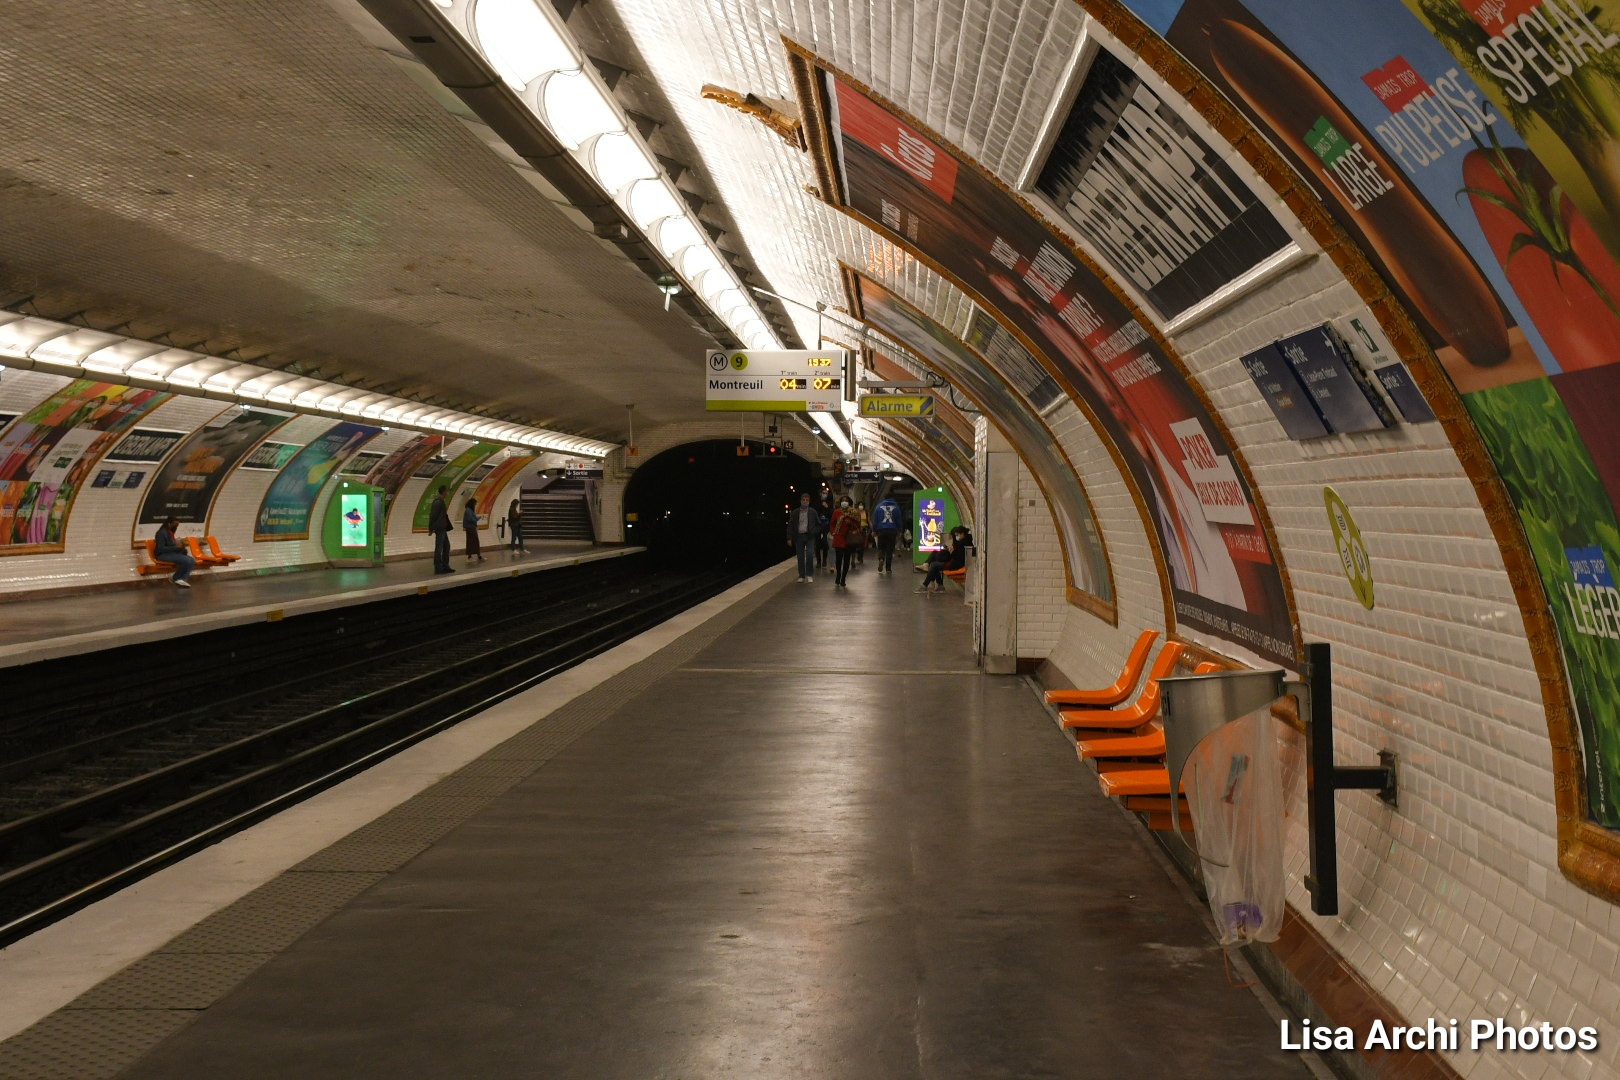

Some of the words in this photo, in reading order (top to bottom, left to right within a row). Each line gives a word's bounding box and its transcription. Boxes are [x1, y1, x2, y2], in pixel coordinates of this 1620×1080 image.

[1373, 78, 1402, 100] JAMAIS
[1396, 69, 1417, 88] TROP
[1374, 67, 1498, 174] PULPEUSE
[1064, 82, 1246, 291] OBERKAMPF
[1322, 142, 1394, 211] LARGE
[1021, 240, 1077, 294] RÉUNION
[1057, 295, 1101, 339] TARDIVE
[735, 356, 743, 368] 9
[1287, 342, 1308, 365] Sortie
[1250, 356, 1268, 378] Sortie
[1380, 371, 1400, 389] Sortie
[709, 379, 763, 390] Montreuil
[779, 378, 797, 390] 04
[813, 377, 831, 390] 07
[867, 400, 913, 412] Alarme
[1180, 433, 1218, 470] POKER
[1215, 479, 1245, 505] CASINO
[1570, 560, 1590, 574] JAMAIS
[1590, 559, 1605, 574] TROP
